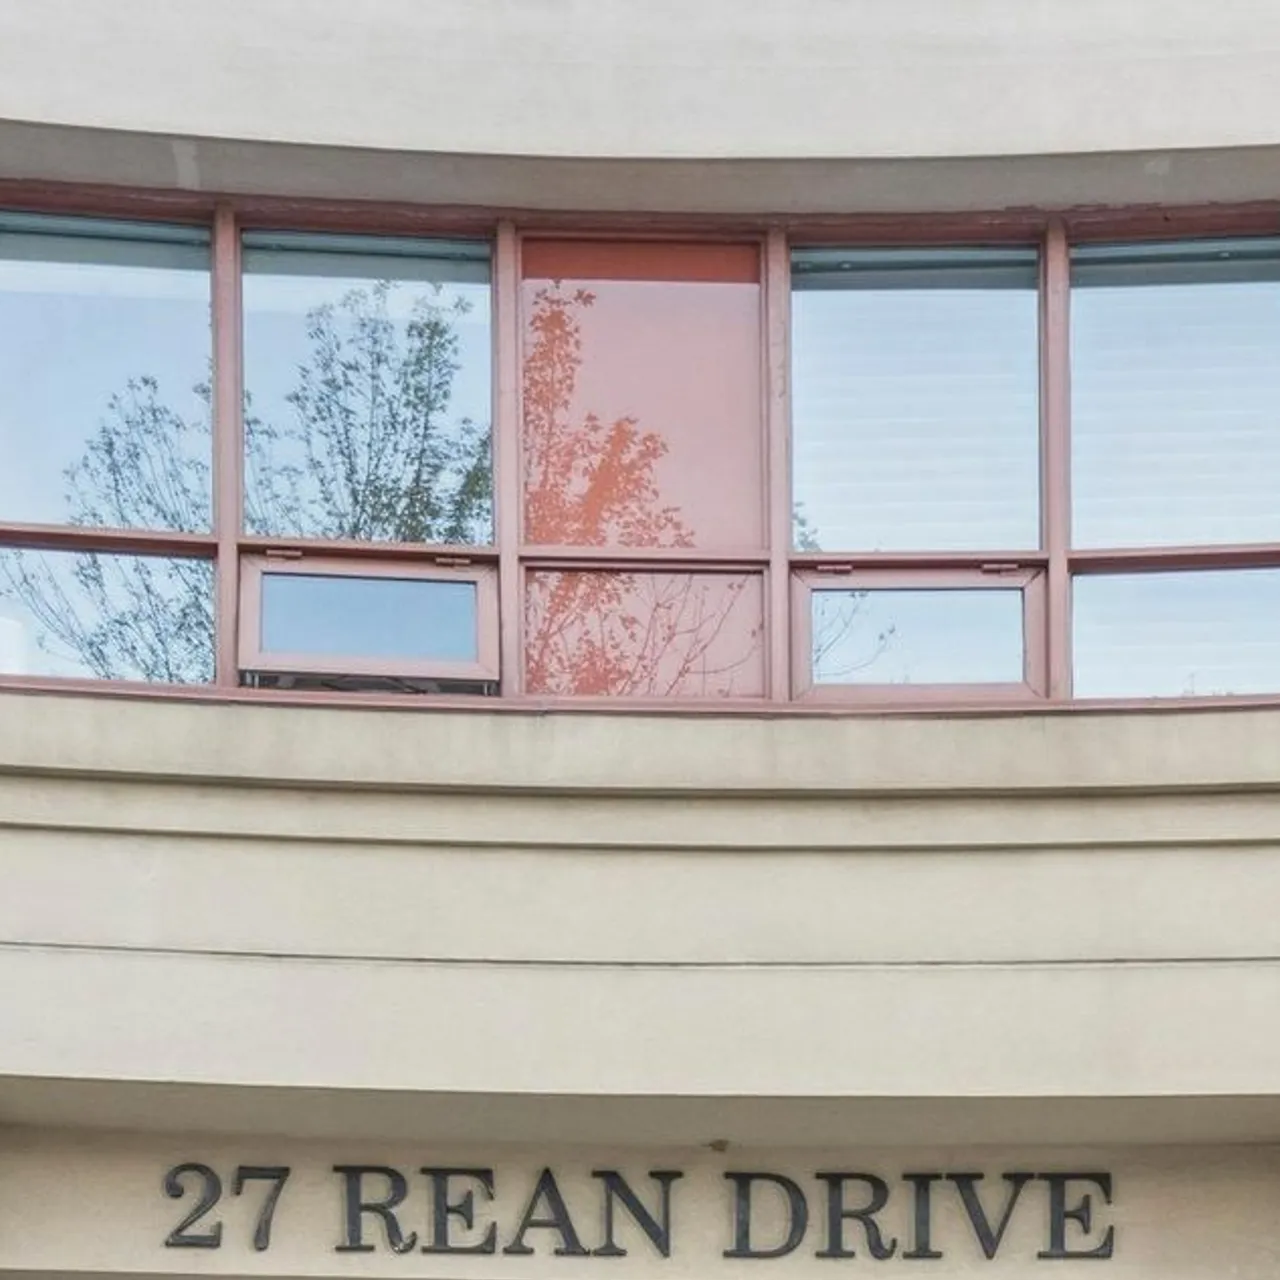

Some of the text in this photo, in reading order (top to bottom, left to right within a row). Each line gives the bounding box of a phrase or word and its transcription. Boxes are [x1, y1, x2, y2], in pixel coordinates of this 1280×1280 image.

[161, 1160, 1122, 1261] 27 REAN DRIVE
